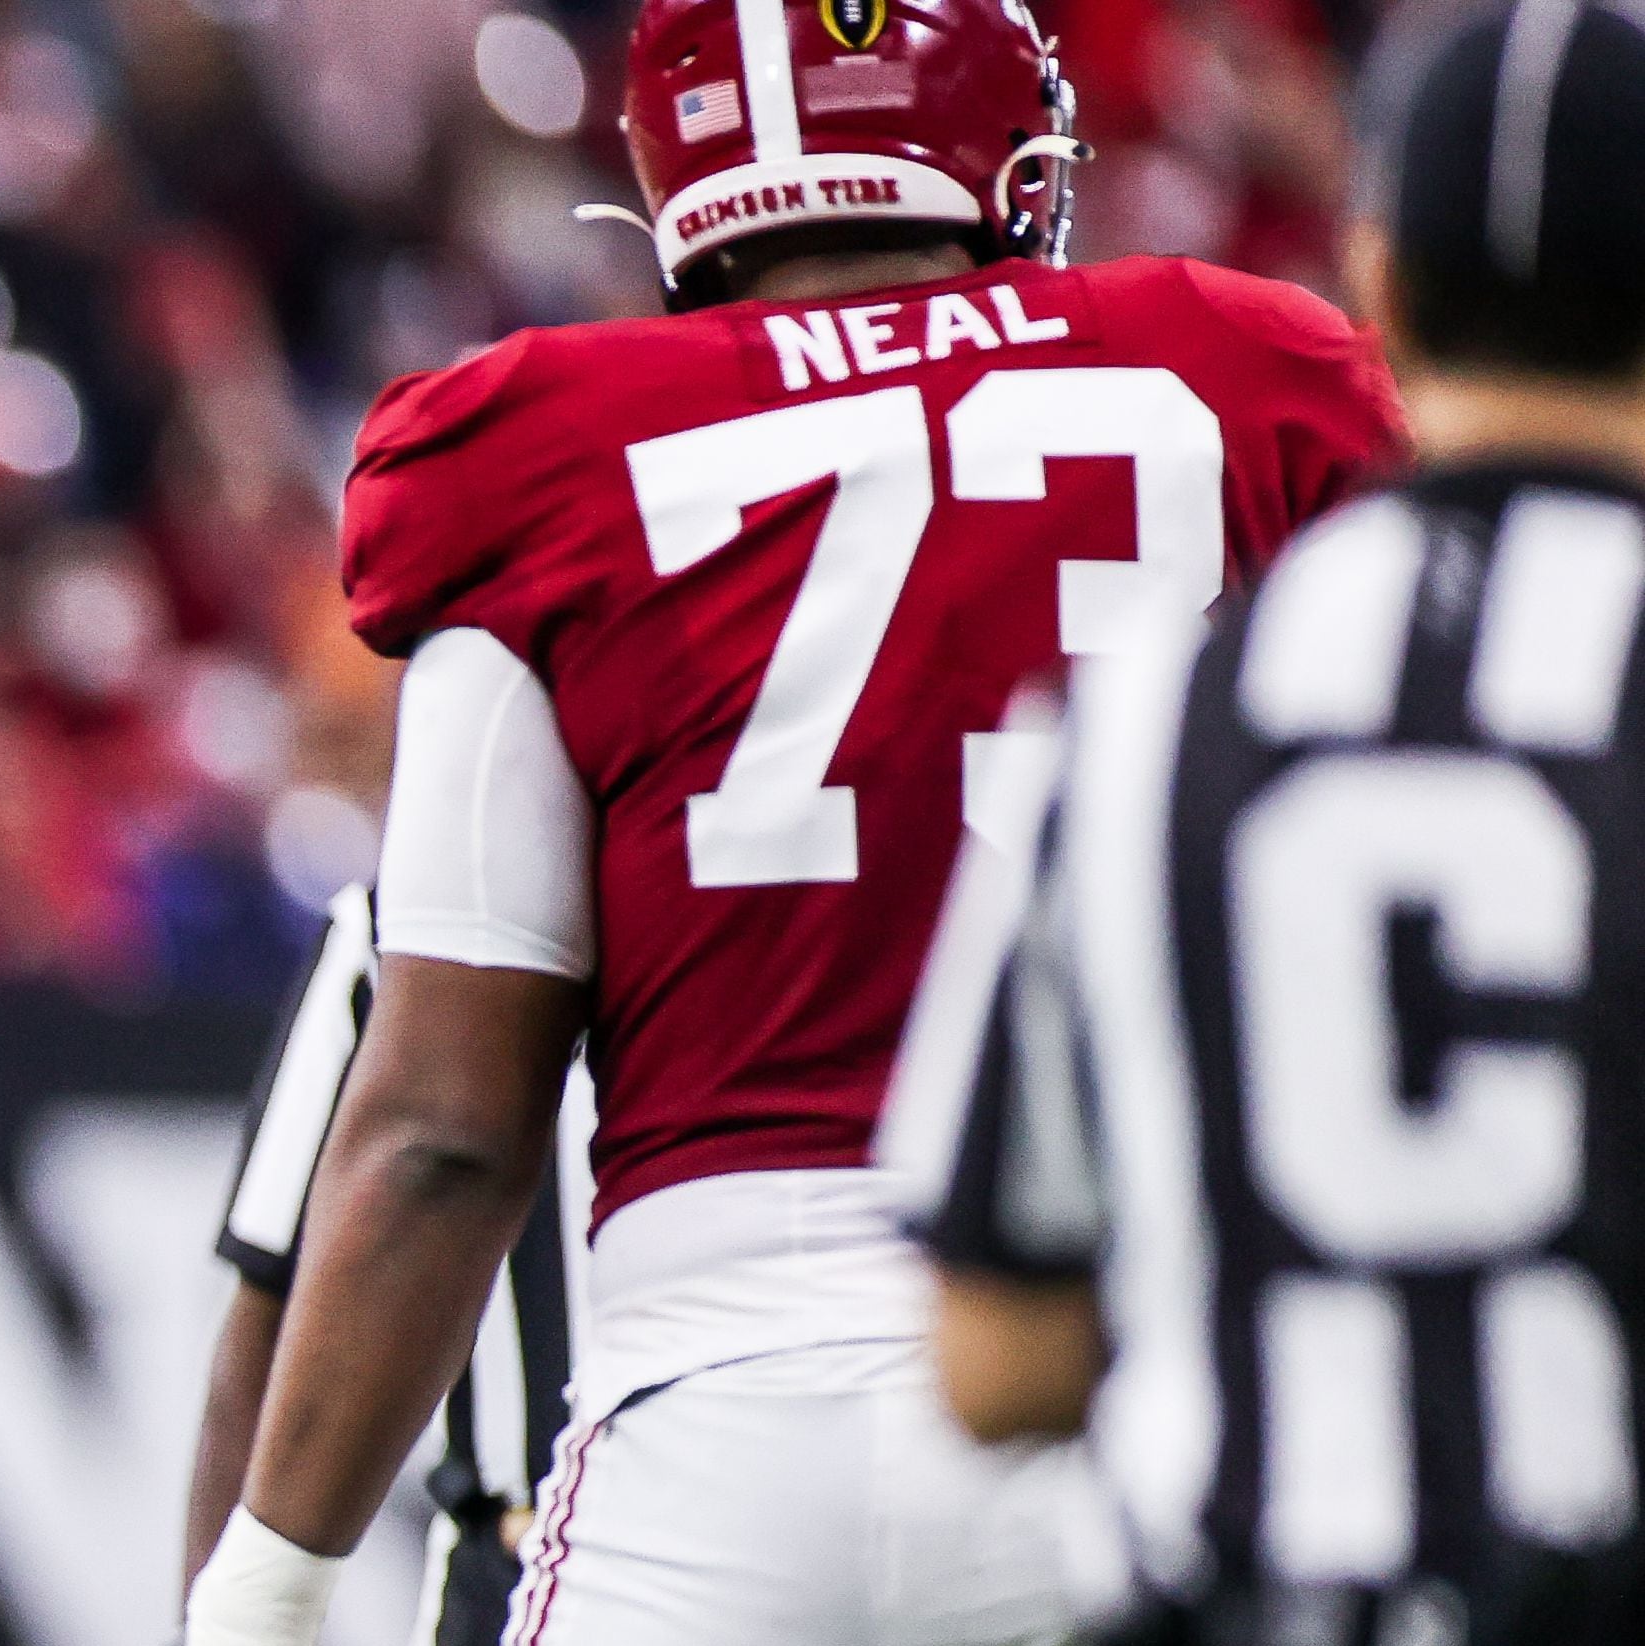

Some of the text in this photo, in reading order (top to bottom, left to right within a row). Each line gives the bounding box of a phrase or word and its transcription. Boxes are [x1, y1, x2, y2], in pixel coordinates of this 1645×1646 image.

[763, 283, 1070, 392] NEAL
[625, 367, 1226, 888] 73
[1229, 745, 1593, 1268] C
